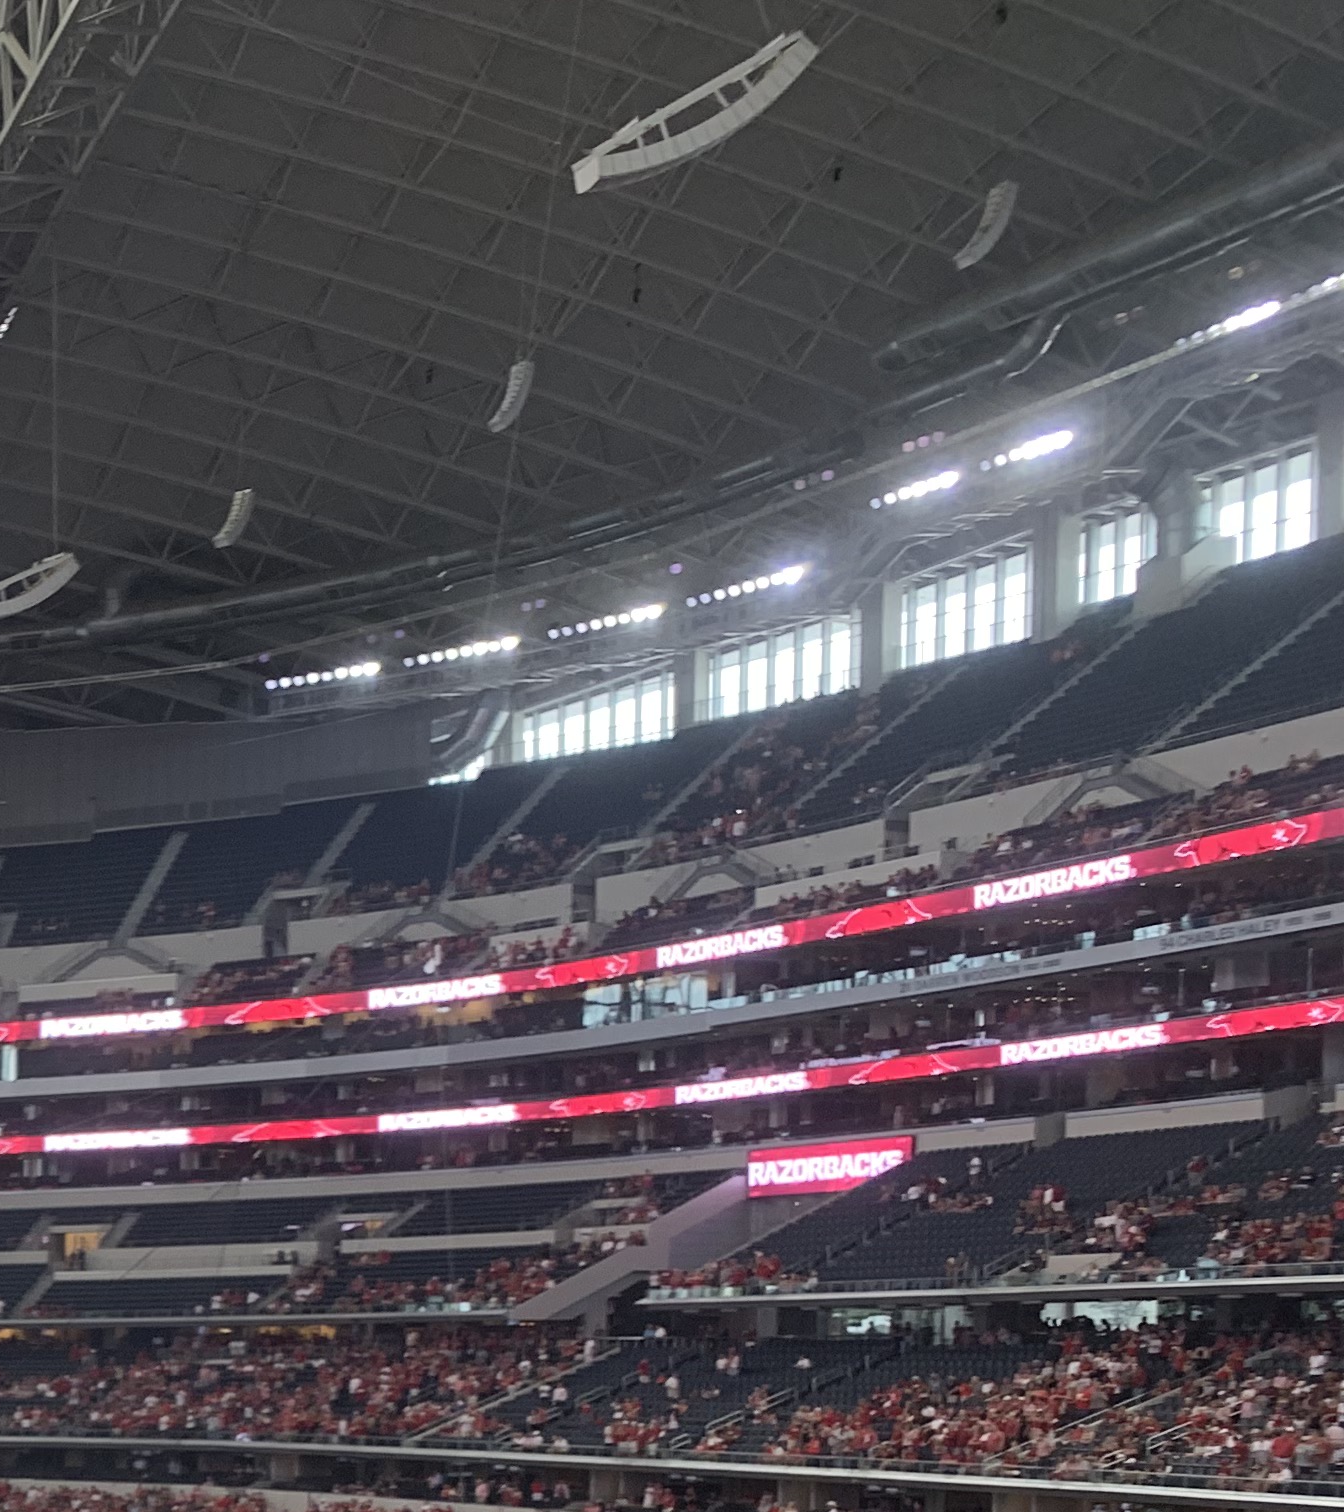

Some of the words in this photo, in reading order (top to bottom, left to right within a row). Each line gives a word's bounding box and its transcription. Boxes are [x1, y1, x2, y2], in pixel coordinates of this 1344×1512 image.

[973, 854, 1132, 909] RAZORBACKS
[656, 924, 785, 968] RAZORBACKS
[368, 974, 504, 1009] RAZORBACKS
[39, 1009, 184, 1038] RAZORBACKS
[1000, 1023, 1165, 1065] RAZORBACKS
[674, 1071, 809, 1105] RAZORBACKS
[377, 1104, 516, 1132] RAZORBACKS
[43, 1128, 191, 1152] RAZORBACKS
[748, 1149, 904, 1187] RAZORBACKS
